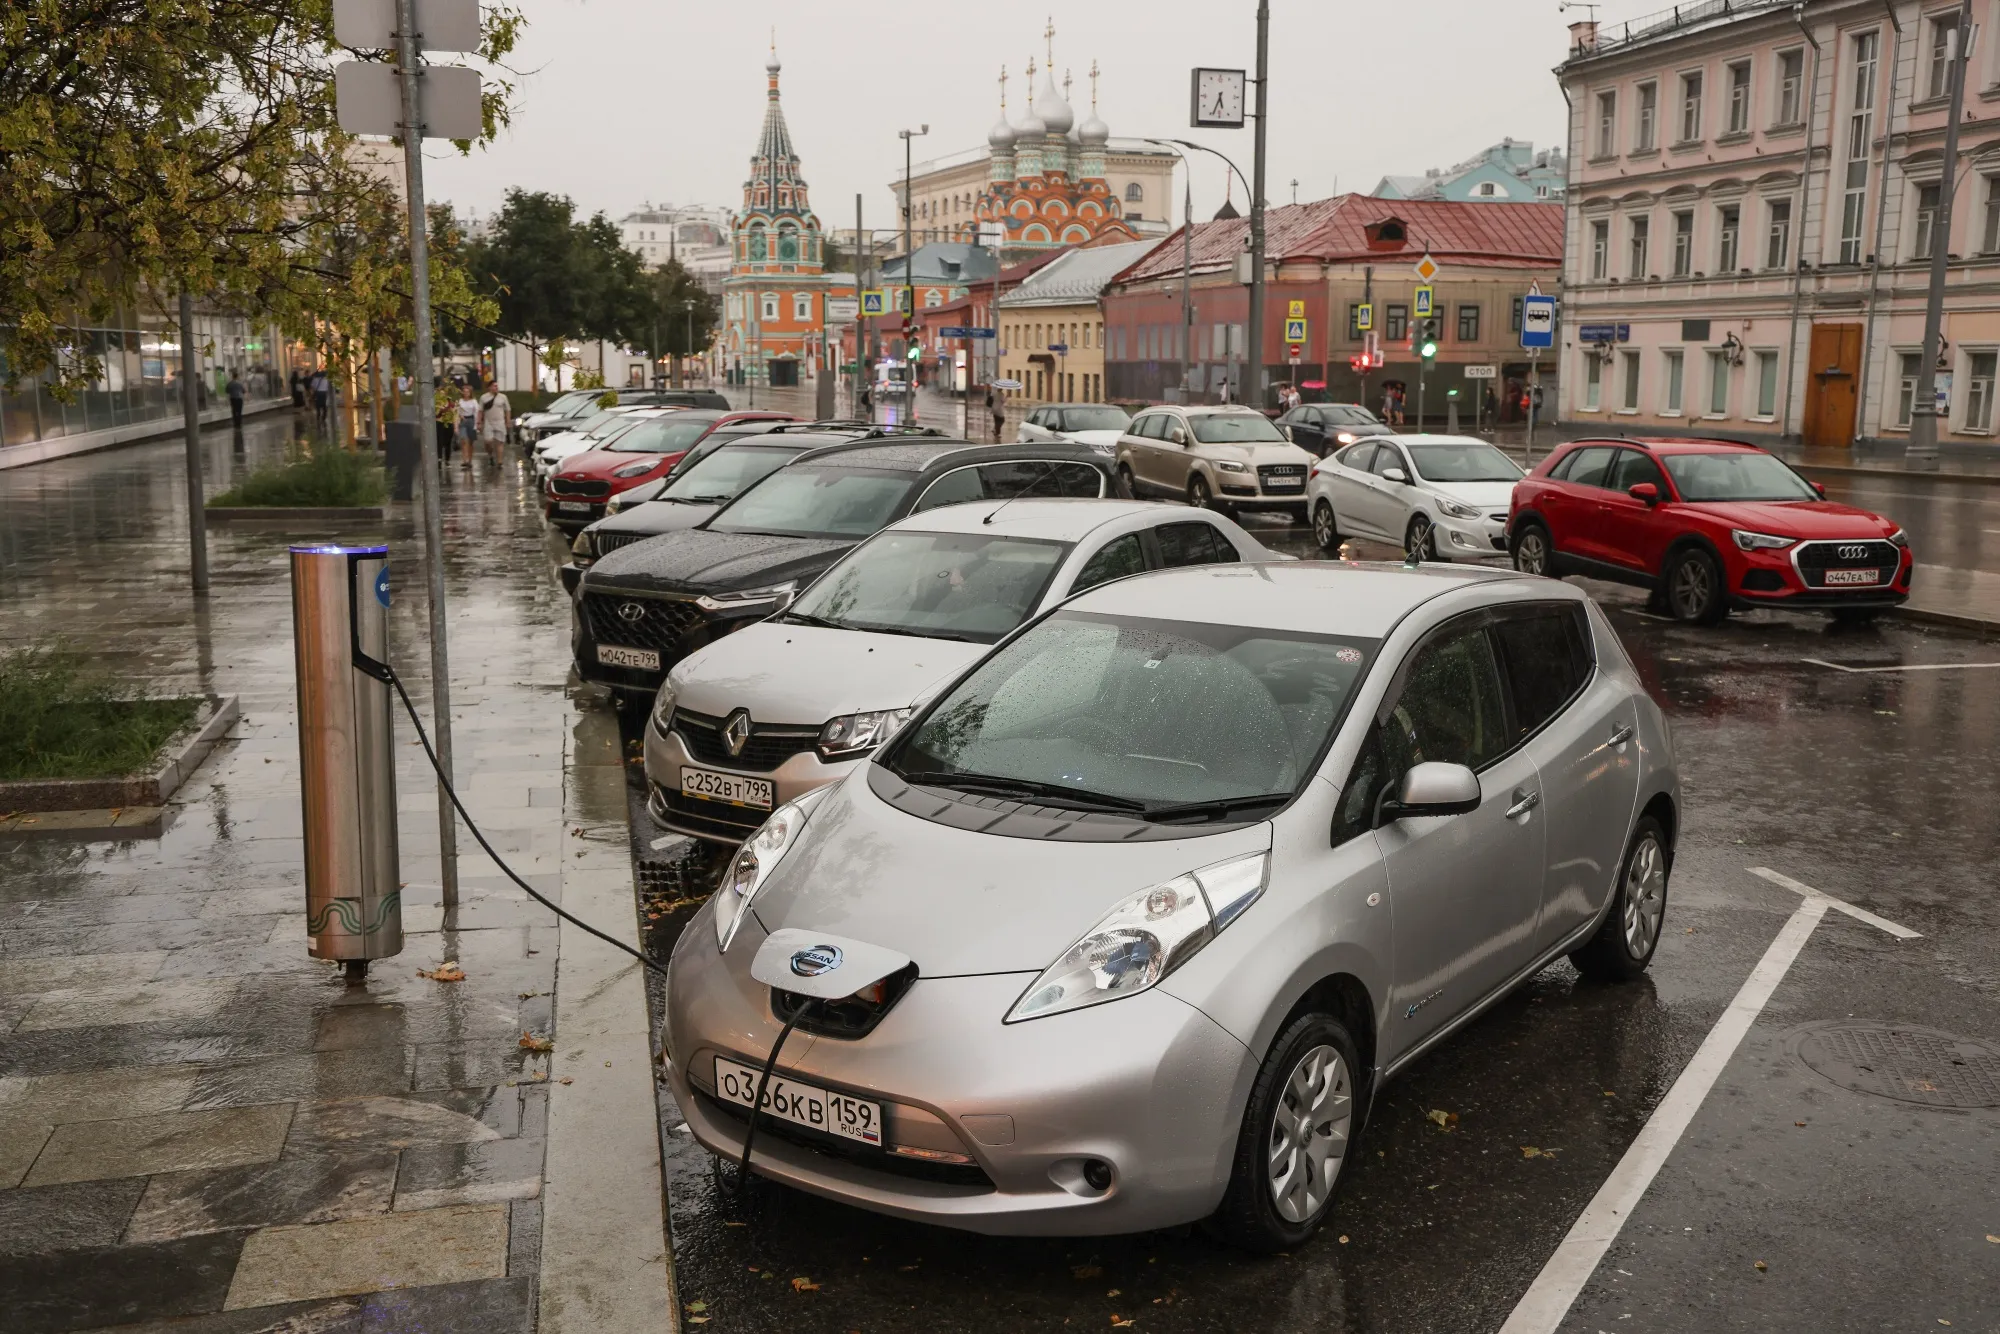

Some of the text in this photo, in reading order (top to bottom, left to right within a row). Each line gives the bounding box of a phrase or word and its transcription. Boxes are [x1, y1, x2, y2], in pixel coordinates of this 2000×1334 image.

[640, 652, 656, 664] 799
[686, 772, 768, 799] С252ВТ 799
[750, 795, 762, 803] RUS
[830, 1097, 872, 1129] 159
[840, 1123, 862, 1137] RUS
